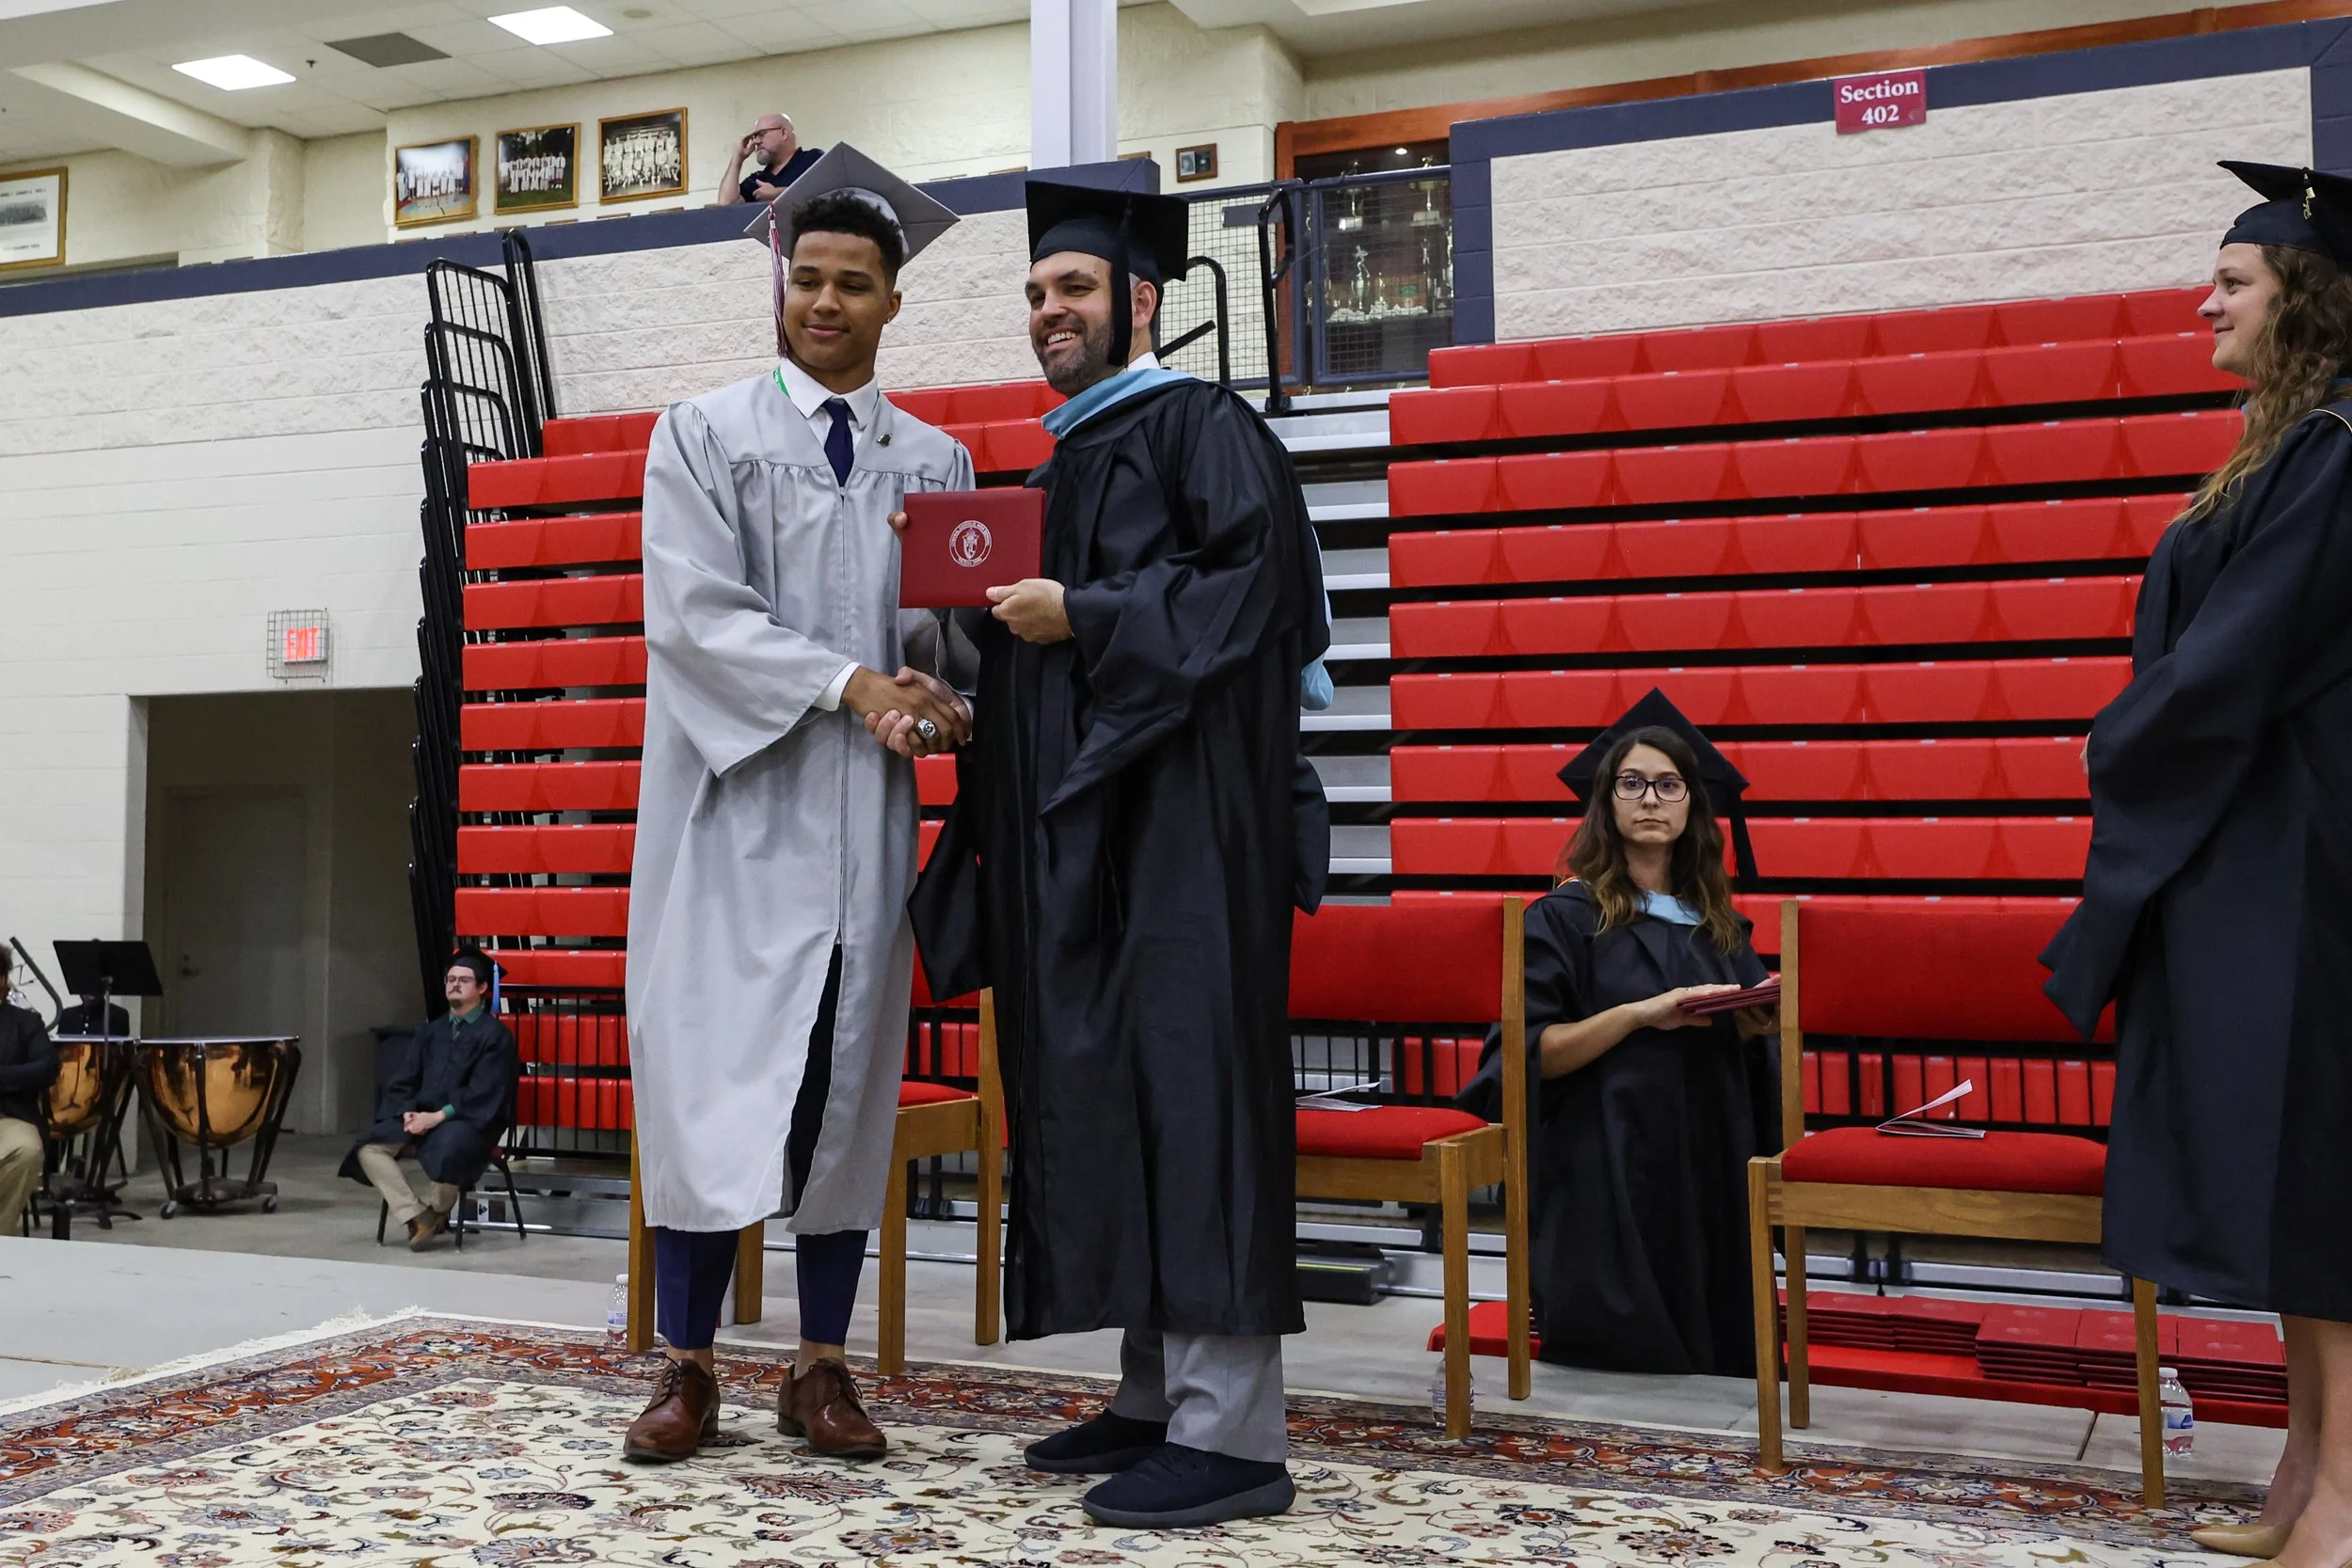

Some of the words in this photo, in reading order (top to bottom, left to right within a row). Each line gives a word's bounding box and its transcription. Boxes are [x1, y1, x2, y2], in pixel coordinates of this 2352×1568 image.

[1840, 80, 1919, 103] Section
[1861, 104, 1899, 125] 402
[286, 627, 318, 659] EXIT
